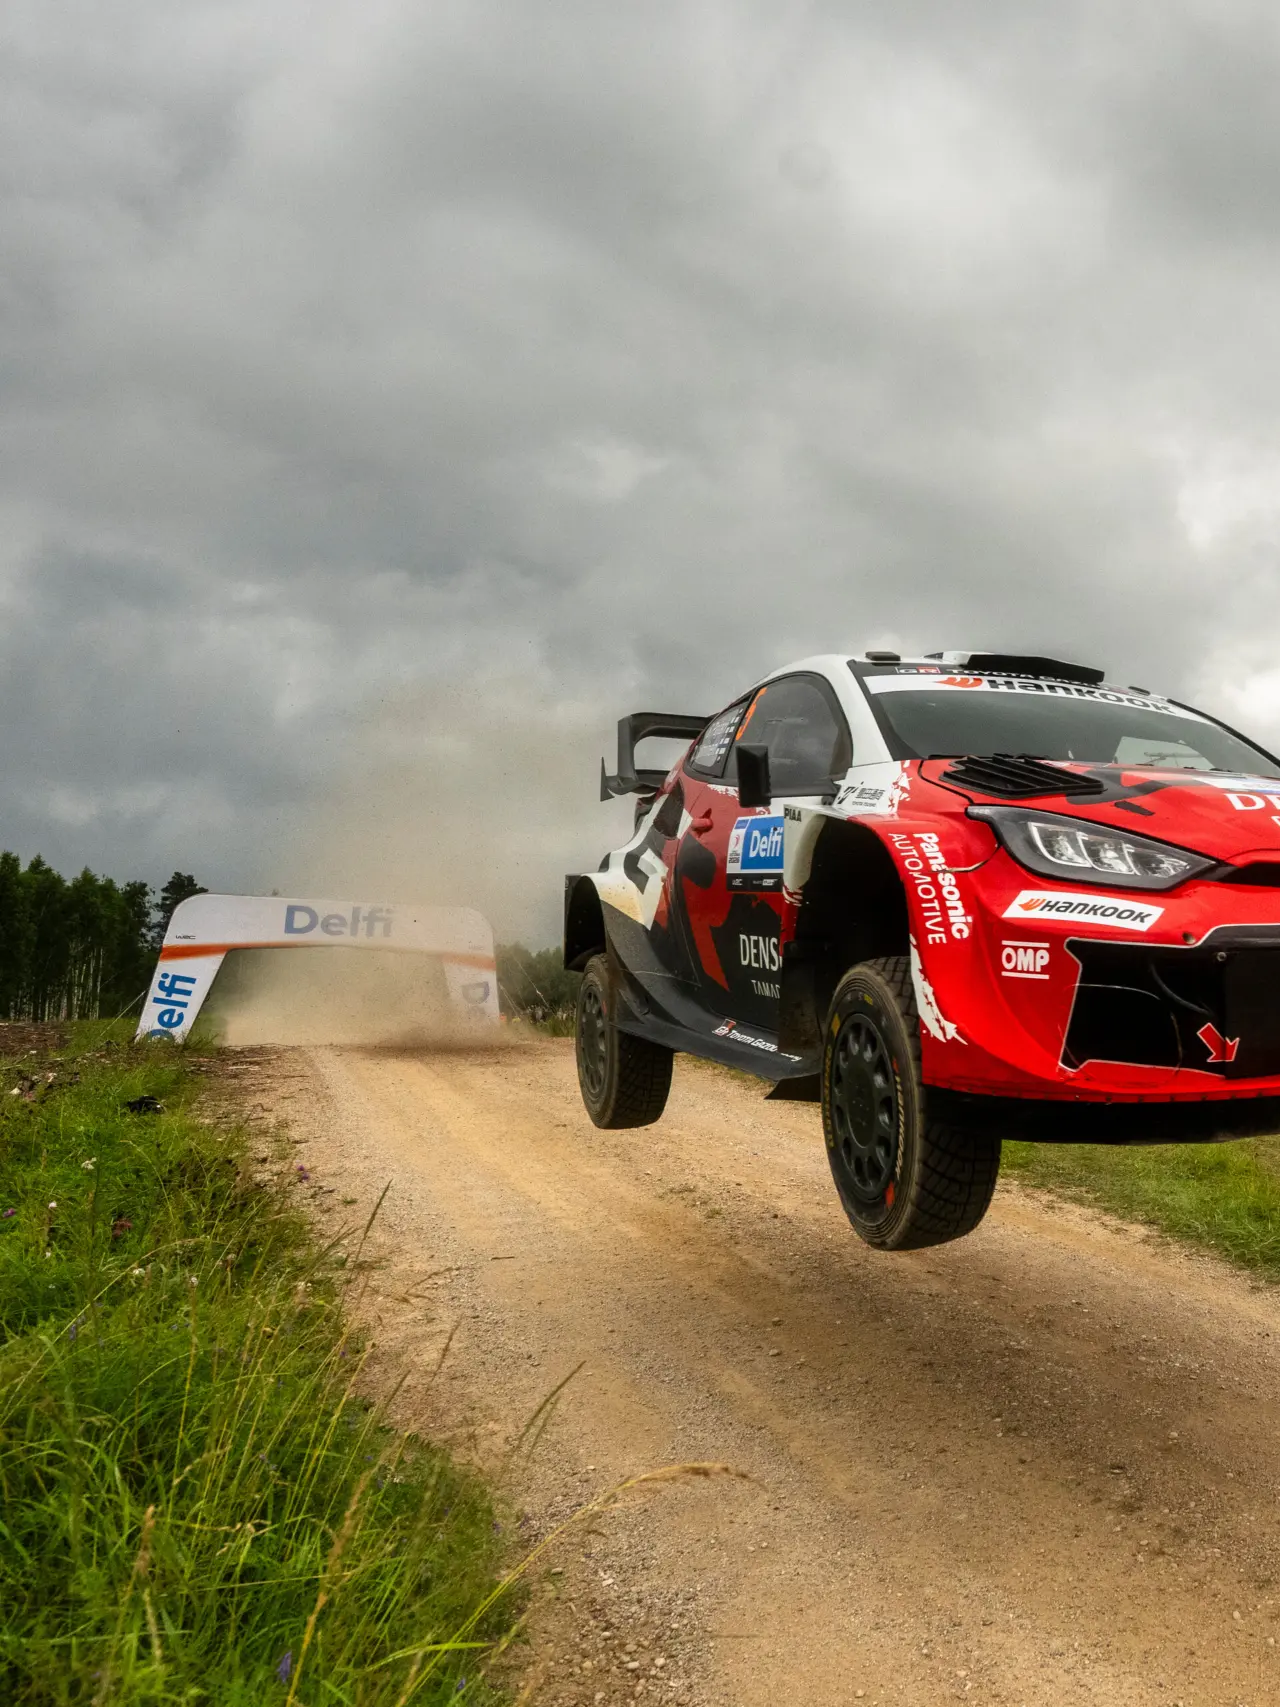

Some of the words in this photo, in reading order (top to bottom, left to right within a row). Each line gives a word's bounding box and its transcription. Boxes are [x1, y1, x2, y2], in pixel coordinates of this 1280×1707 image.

[784, 808, 802, 822] PIAA
[749, 827, 784, 857] Delfi
[888, 833, 947, 945] AUTOMOTIVE
[912, 833, 973, 939] Panasonic
[285, 905, 392, 938] Delfi
[739, 934, 783, 971] DENS
[1001, 947, 1050, 972] OMP
[727, 1030, 755, 1044] TOYOTA
